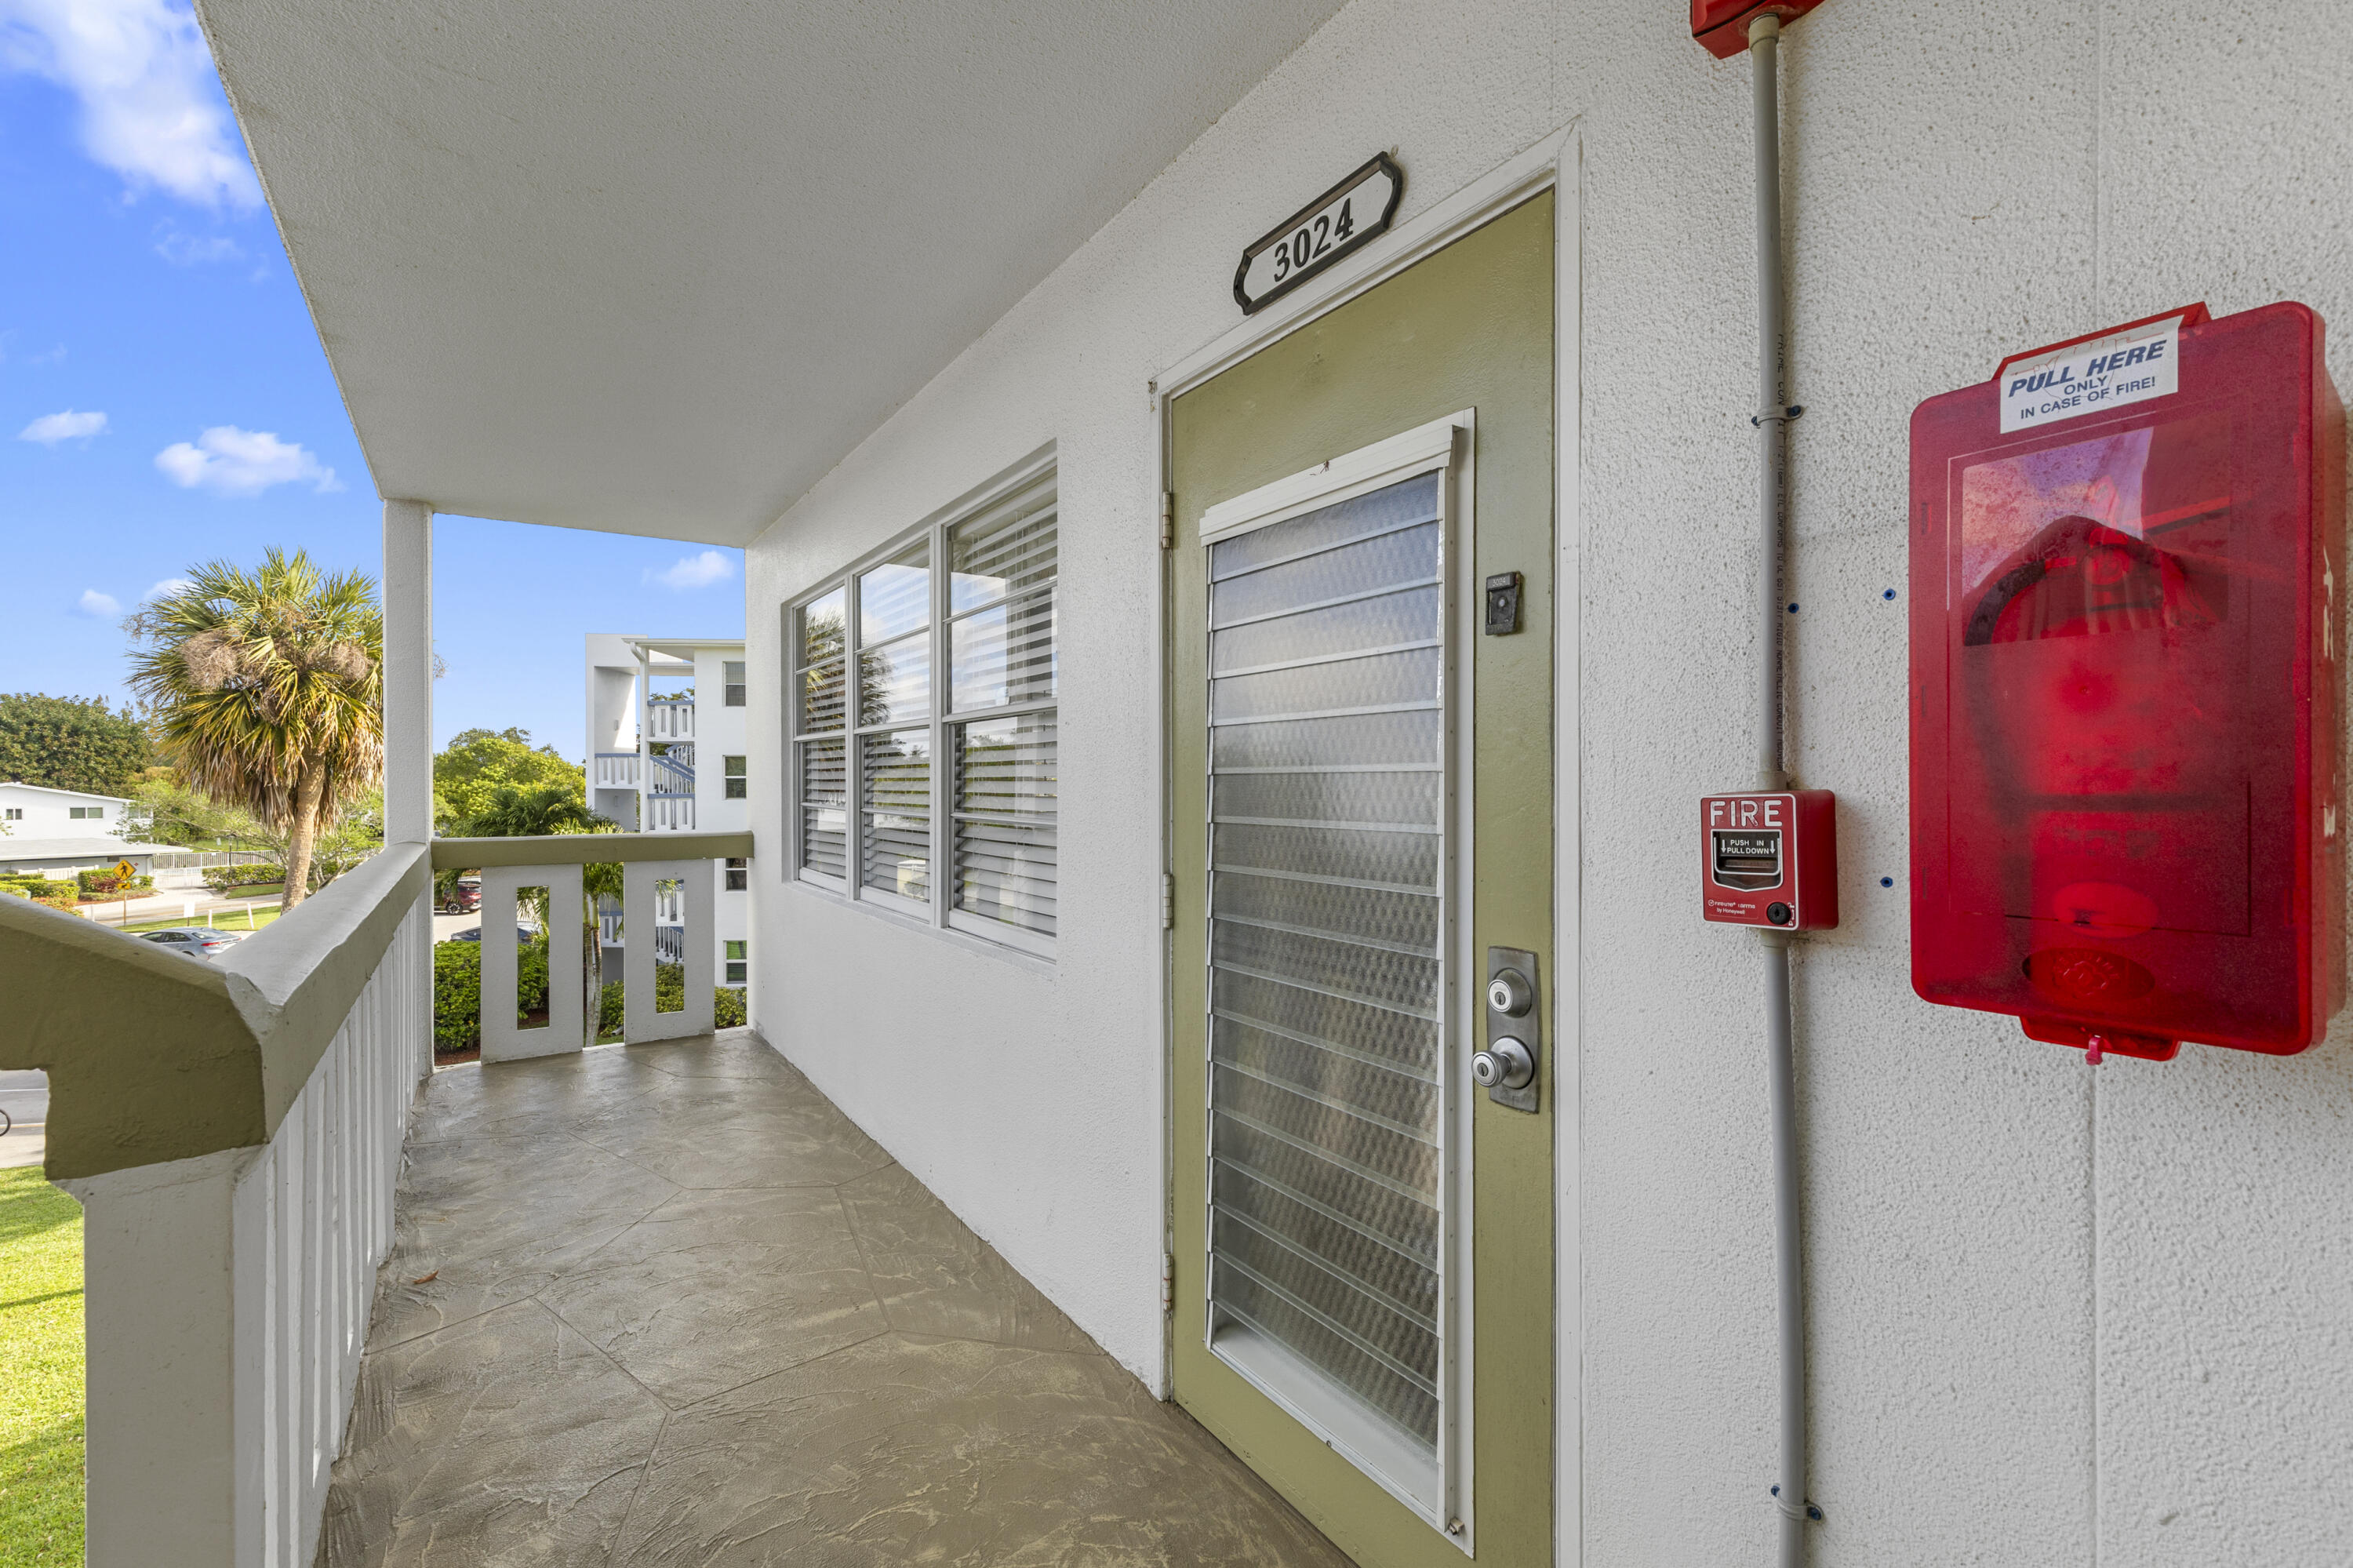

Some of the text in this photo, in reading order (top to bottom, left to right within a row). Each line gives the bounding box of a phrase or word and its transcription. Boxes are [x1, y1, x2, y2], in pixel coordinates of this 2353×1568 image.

[1274, 198, 1353, 282] 3024
[2008, 339, 2168, 398] PULL HERE
[2064, 375, 2108, 396] ONLY
[2020, 376, 2156, 420] IN CASE OF FIRE!
[1710, 799, 1783, 827] FIRE
